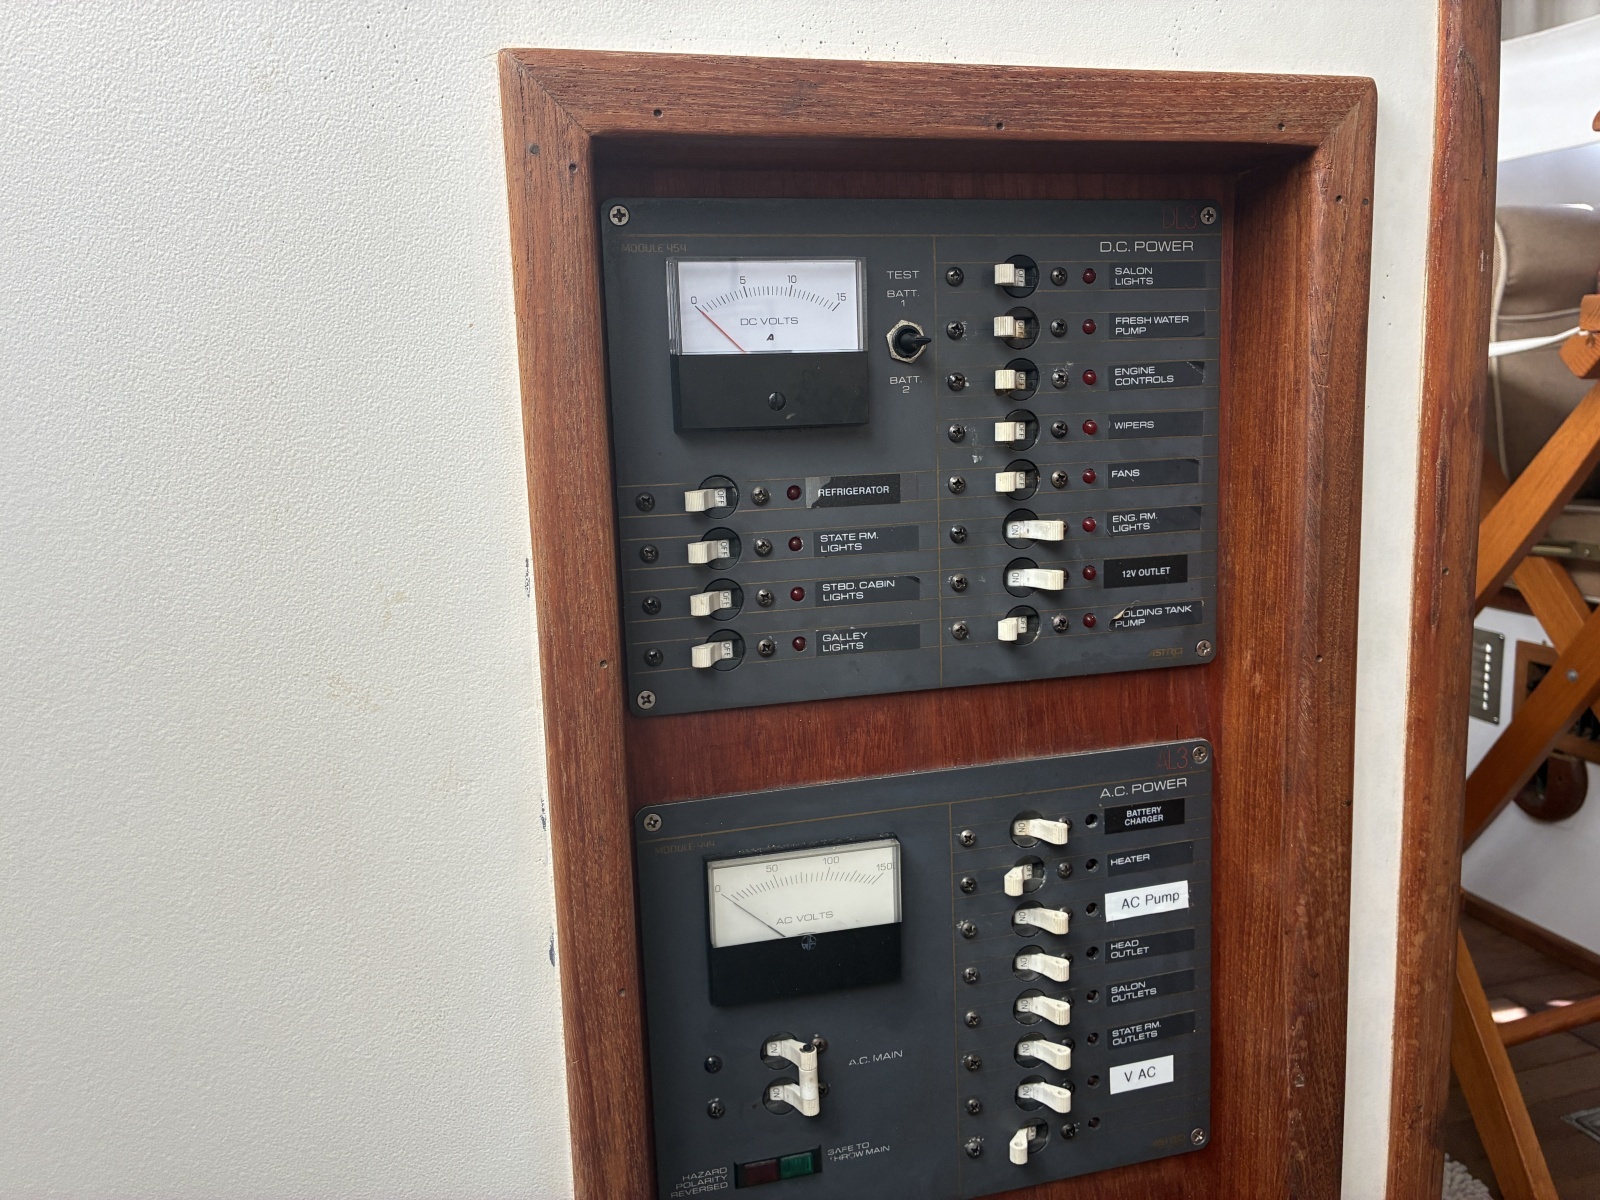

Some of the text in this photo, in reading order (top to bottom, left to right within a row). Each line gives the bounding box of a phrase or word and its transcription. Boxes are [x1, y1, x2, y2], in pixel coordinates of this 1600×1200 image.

[1100, 240, 1194, 252] D.C. POWER
[886, 270, 920, 279] TEST
[1115, 267, 1153, 275] SALON
[739, 275, 747, 285] 5
[787, 274, 797, 284] 10
[1115, 277, 1154, 286] LIGHTS
[837, 293, 847, 302] 15
[887, 289, 920, 298] BATT.
[690, 296, 698, 305] 0
[901, 299, 905, 307] 1
[740, 317, 799, 326] DC VOLTS
[1115, 315, 1190, 325] FRESH WATER
[1115, 327, 1147, 335] PUMP
[1115, 366, 1155, 376] ENGINE
[890, 376, 922, 385] BATT.
[1115, 375, 1174, 386] CONTROLS
[1114, 421, 1155, 430] WIPERS
[1111, 469, 1140, 478] FANS
[817, 485, 890, 497] REFRIGERATOR
[1112, 511, 1158, 523] ENG. RM.
[1112, 522, 1151, 533] LIGHTS
[820, 531, 879, 543] STATE RM.
[820, 543, 863, 553] LIGHTS
[1122, 566, 1171, 578] 12V OUTLET
[822, 580, 895, 592] STBD. CABIN
[823, 592, 864, 602] LIGHTS
[1165, 605, 1192, 615] TANK
[1115, 619, 1146, 628] PUMP
[822, 632, 868, 642] GALLEY
[823, 642, 864, 652] LIGHTS
[1100, 777, 1188, 799] A.C. POWER
[1126, 806, 1162, 818] BATTERY
[1124, 814, 1164, 826] CHARGER
[823, 856, 840, 865] 100
[1110, 853, 1150, 866] HEATER
[766, 864, 778, 873] 50
[876, 862, 893, 872] 150
[714, 885, 721, 893] 0
[1121, 892, 1180, 910] AC Pump
[776, 911, 834, 926] AC VOLTS
[1110, 940, 1139, 950] HEAD
[1110, 947, 1149, 959] OUTLET
[1111, 981, 1146, 994] SALON
[1111, 987, 1157, 1003] OUTLETS
[1112, 1021, 1162, 1037] STATE RM.
[1112, 1030, 1158, 1046] OUTLETS
[848, 1050, 903, 1066] A.C. MAIN
[1124, 1066, 1156, 1082] V AC
[827, 1141, 870, 1156] SAFE TO
[865, 1145, 890, 1156] MAIN
[682, 1167, 728, 1181] HAZARD
[675, 1174, 728, 1190] POLARITY
[671, 1182, 728, 1198] REVERSED
